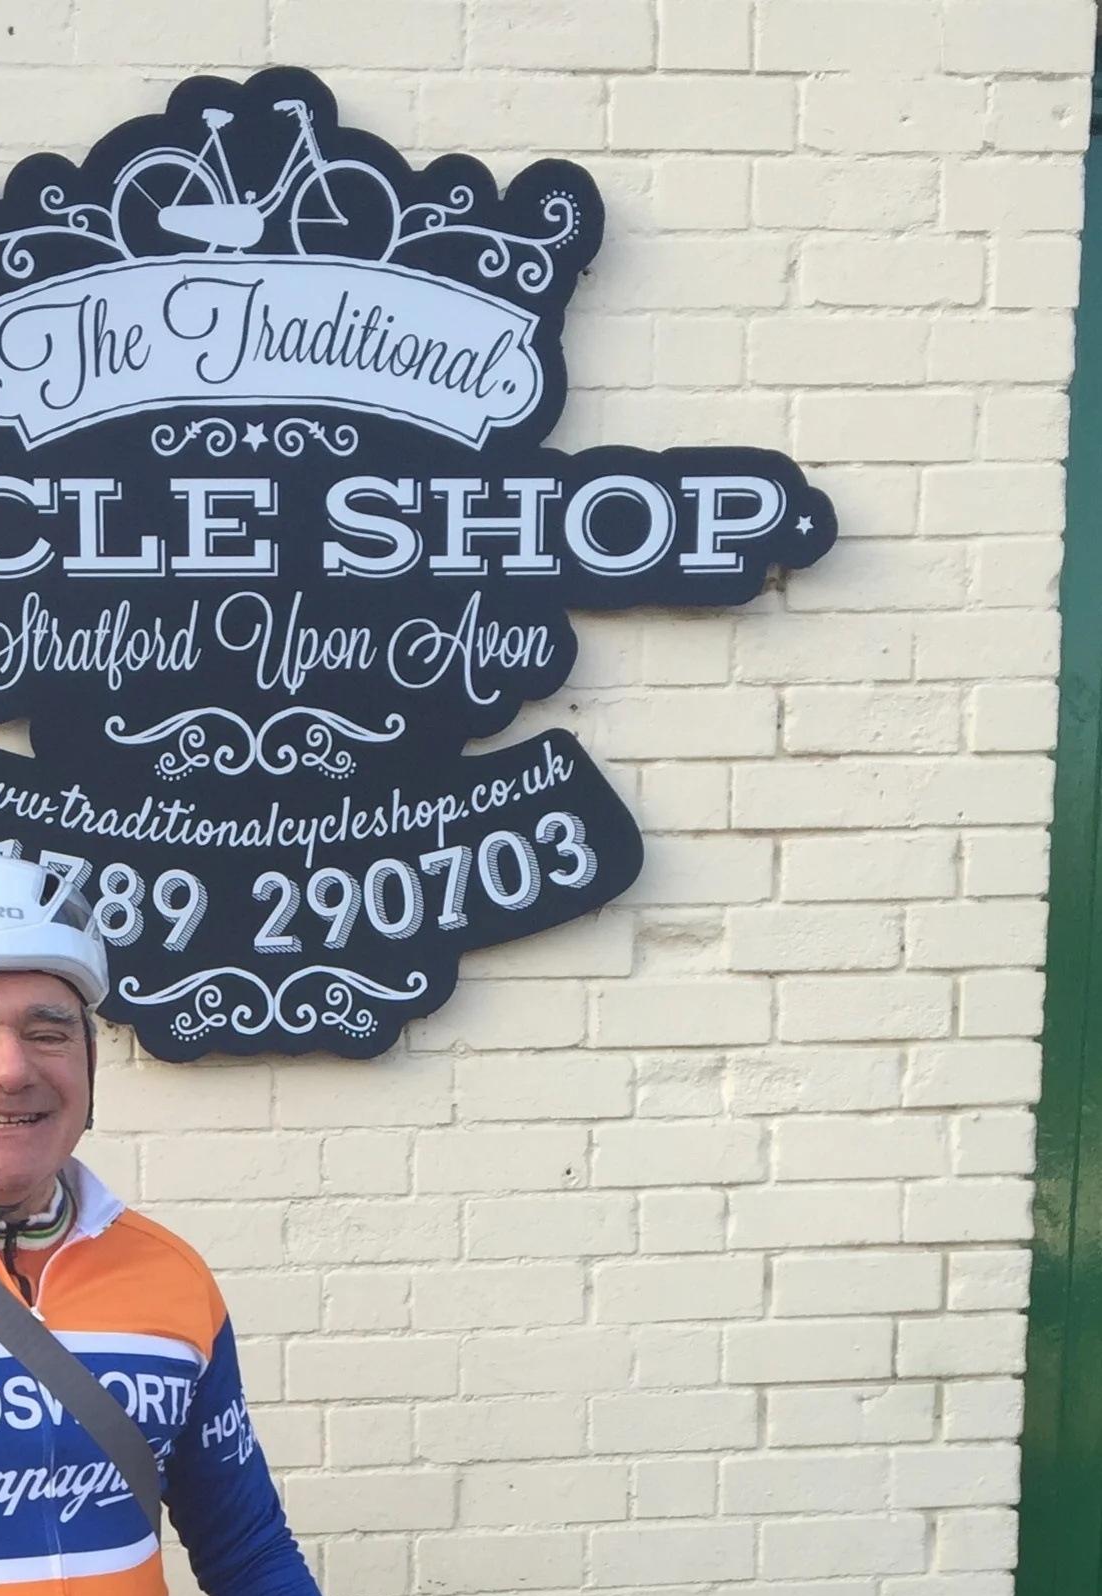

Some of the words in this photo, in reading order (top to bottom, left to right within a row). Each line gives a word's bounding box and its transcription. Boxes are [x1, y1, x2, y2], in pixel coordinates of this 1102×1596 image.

[163, 277, 513, 399] Traditional
[323, 474, 787, 577] SHOP
[215, 590, 377, 696] Upon
[387, 590, 554, 705] Avon
[253, 811, 598, 955] 290703
